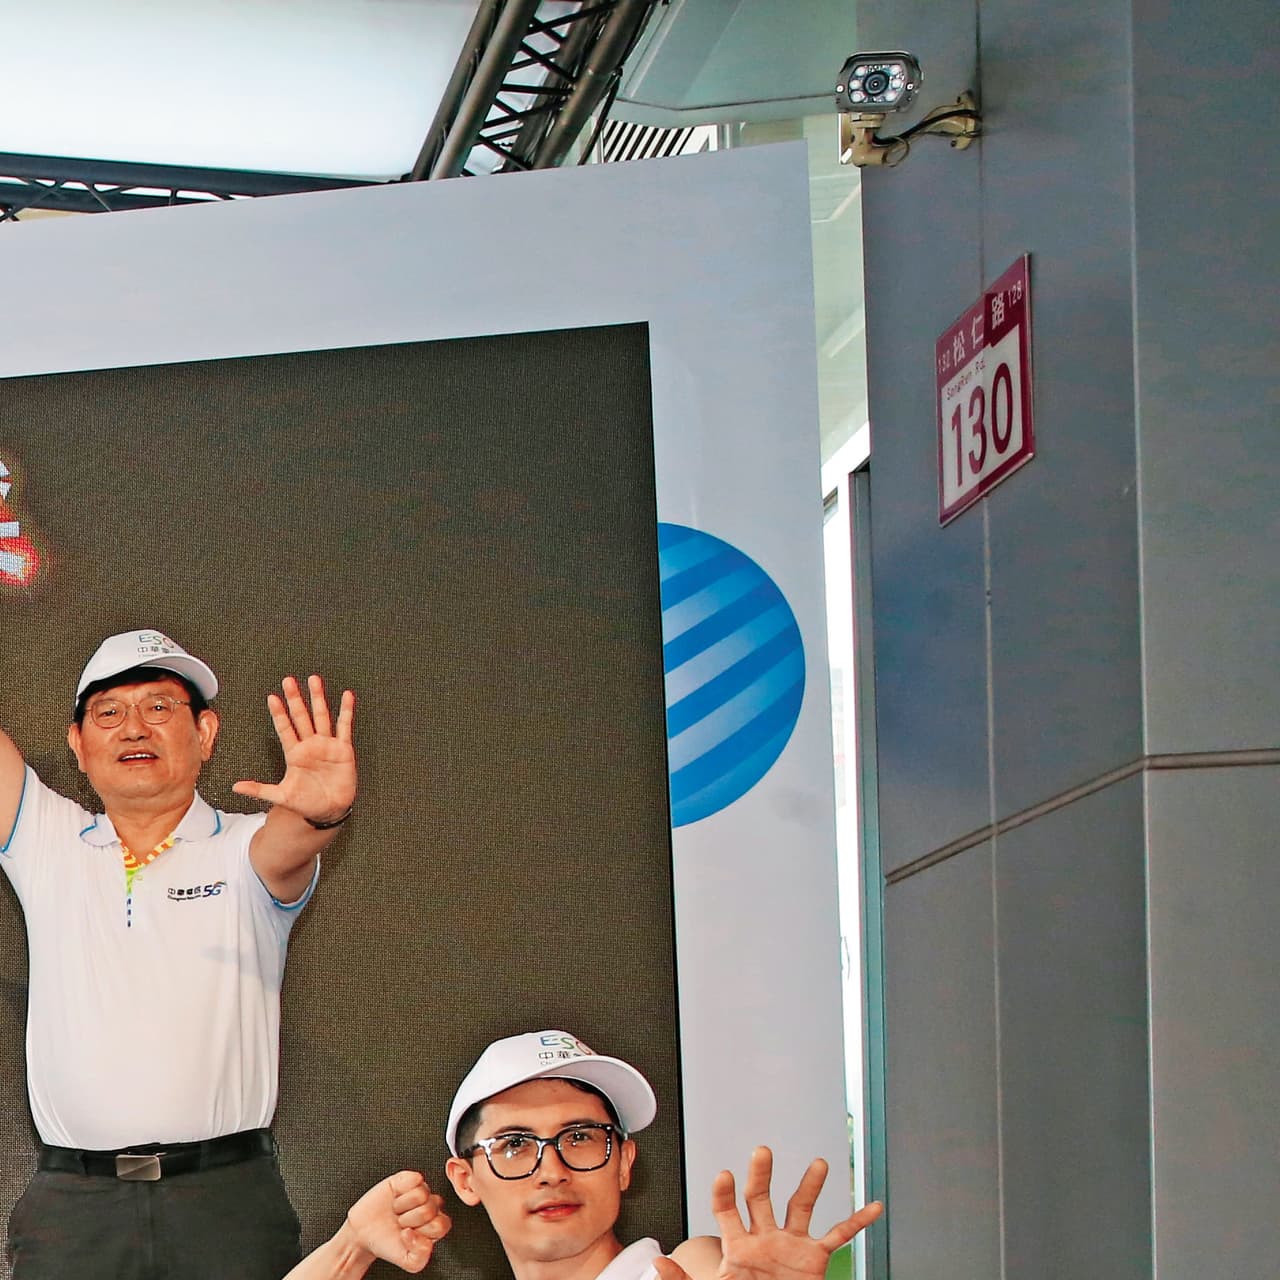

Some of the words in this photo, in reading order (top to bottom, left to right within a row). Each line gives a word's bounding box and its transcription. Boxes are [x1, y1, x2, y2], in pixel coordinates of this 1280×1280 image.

[952, 292, 1006, 367] 松仁路
[1007, 279, 1022, 308] 128
[951, 362, 1014, 488] 130
